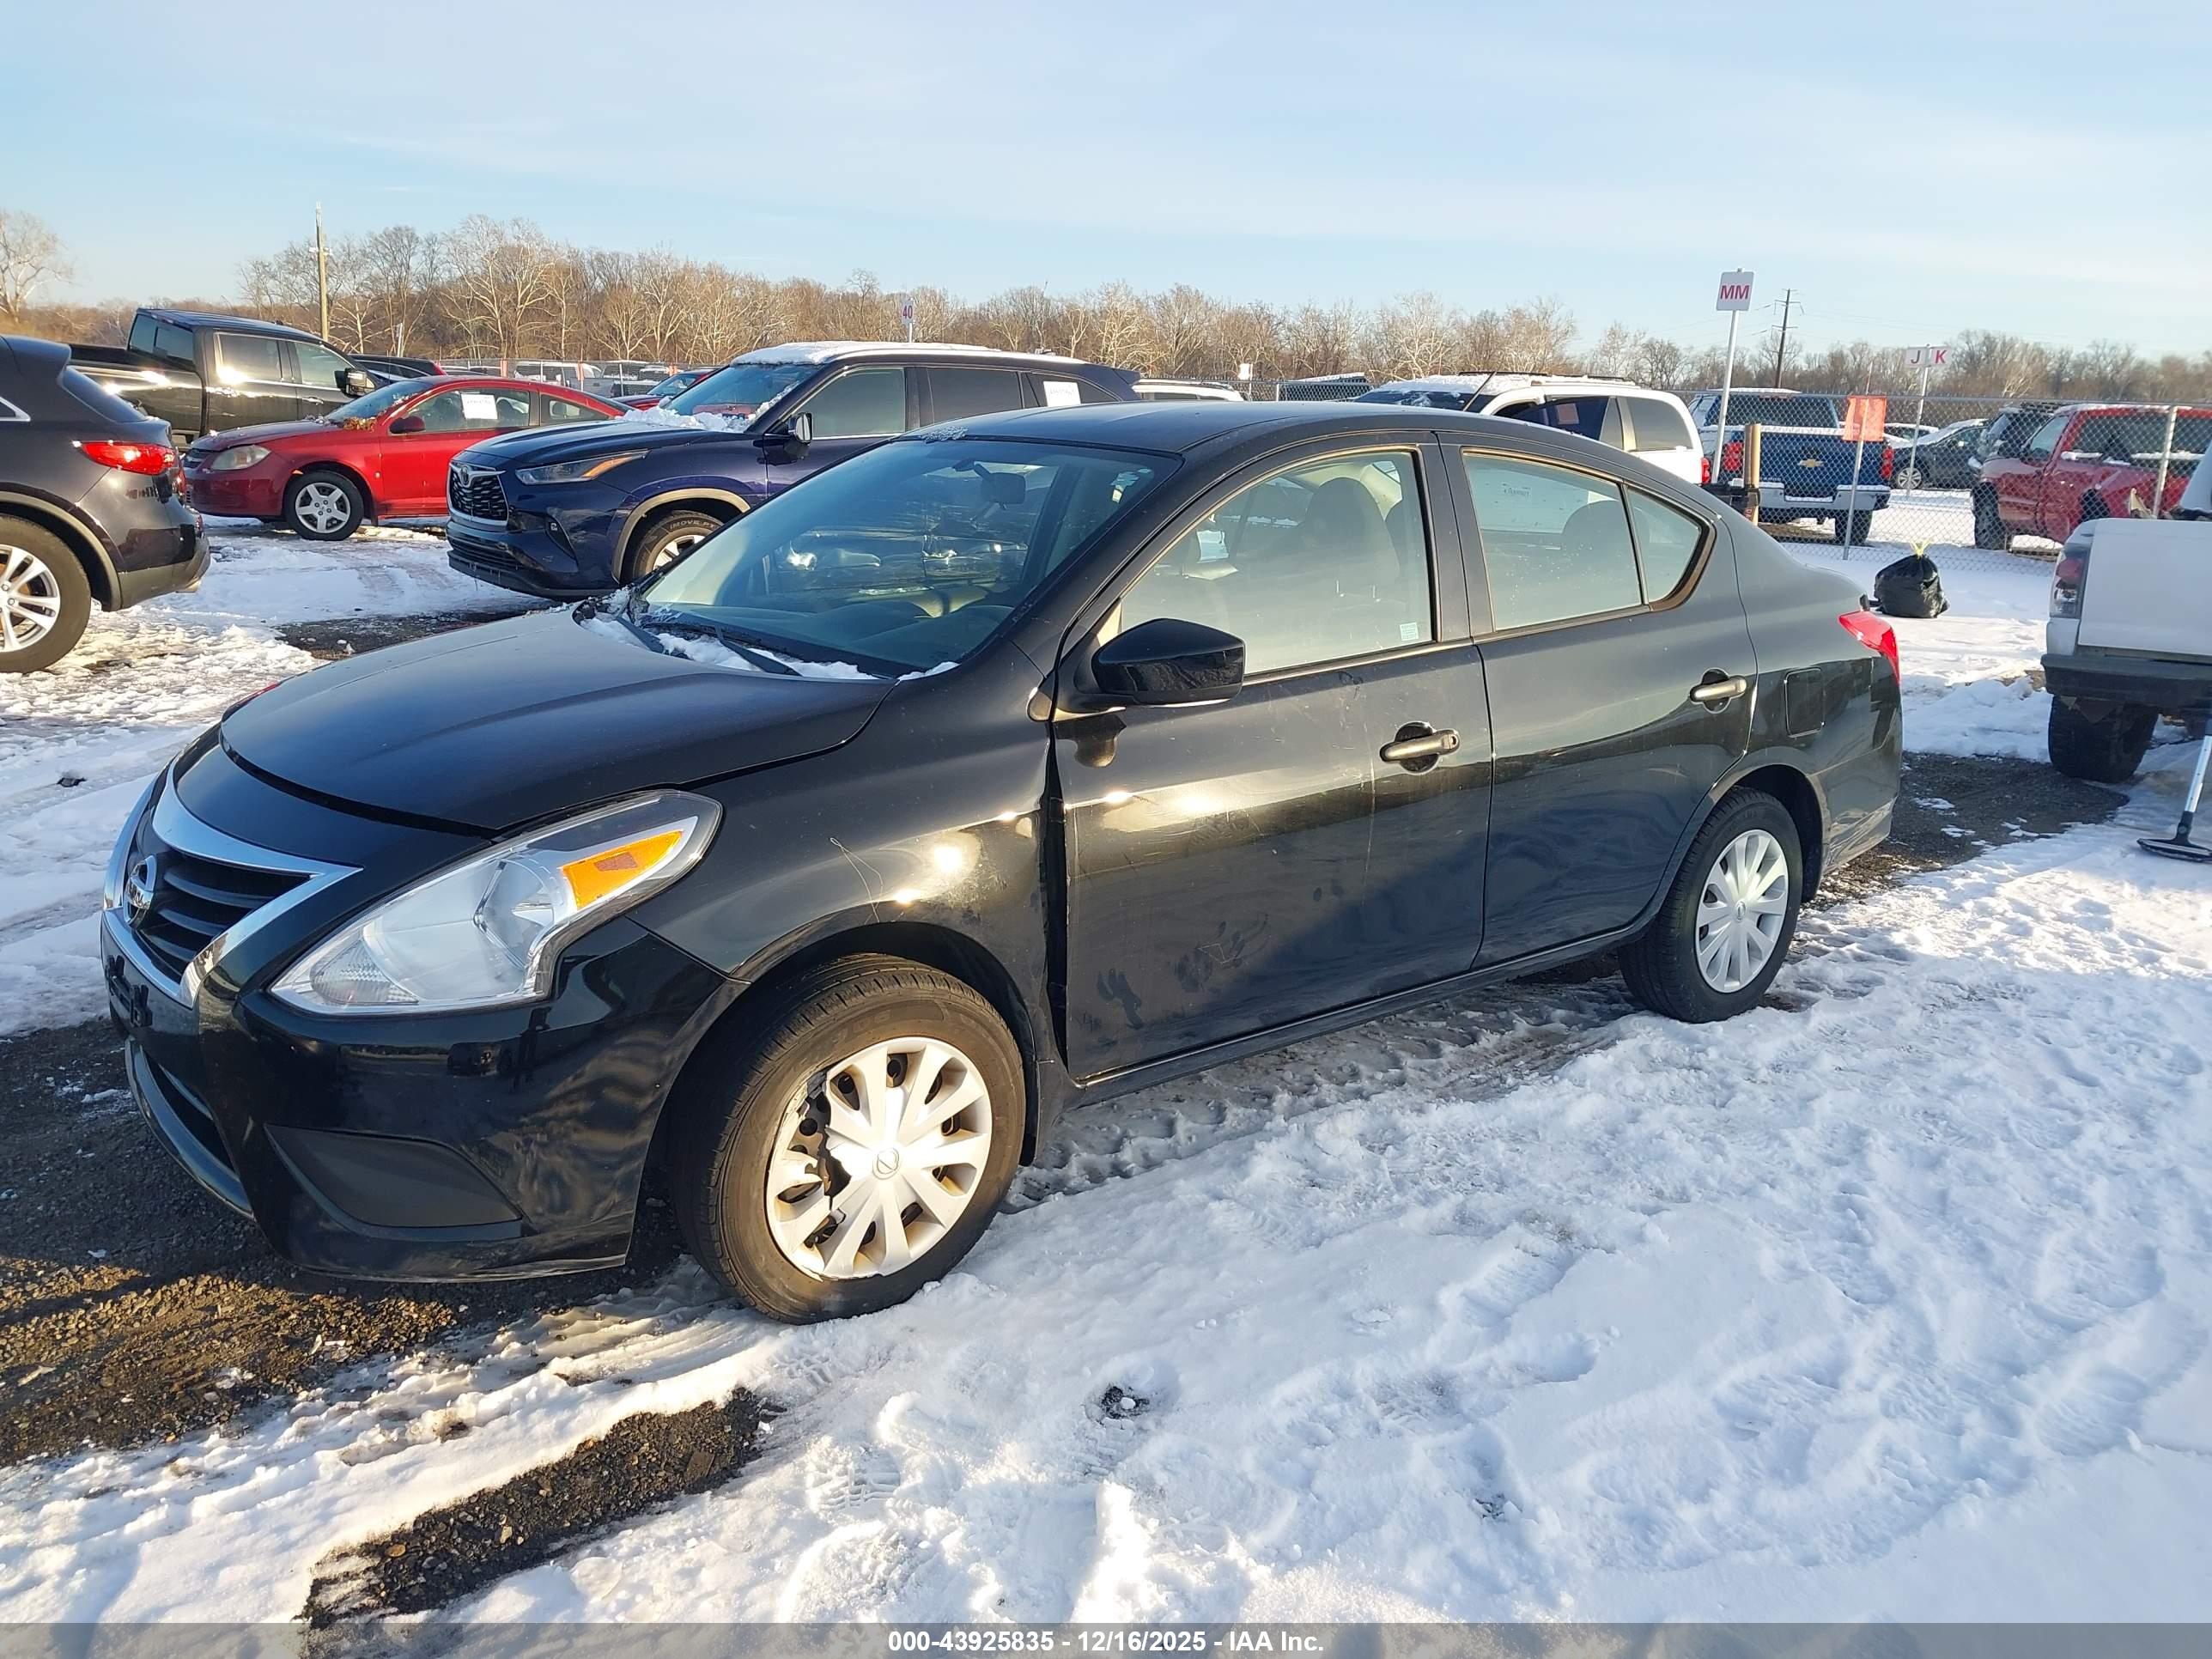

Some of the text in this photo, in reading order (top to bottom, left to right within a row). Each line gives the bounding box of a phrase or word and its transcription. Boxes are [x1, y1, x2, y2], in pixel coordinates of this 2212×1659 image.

[1720, 285, 1750, 300] MM
[902, 305, 913, 319] 40
[1910, 349, 1922, 364] J
[1935, 349, 1948, 364] K
